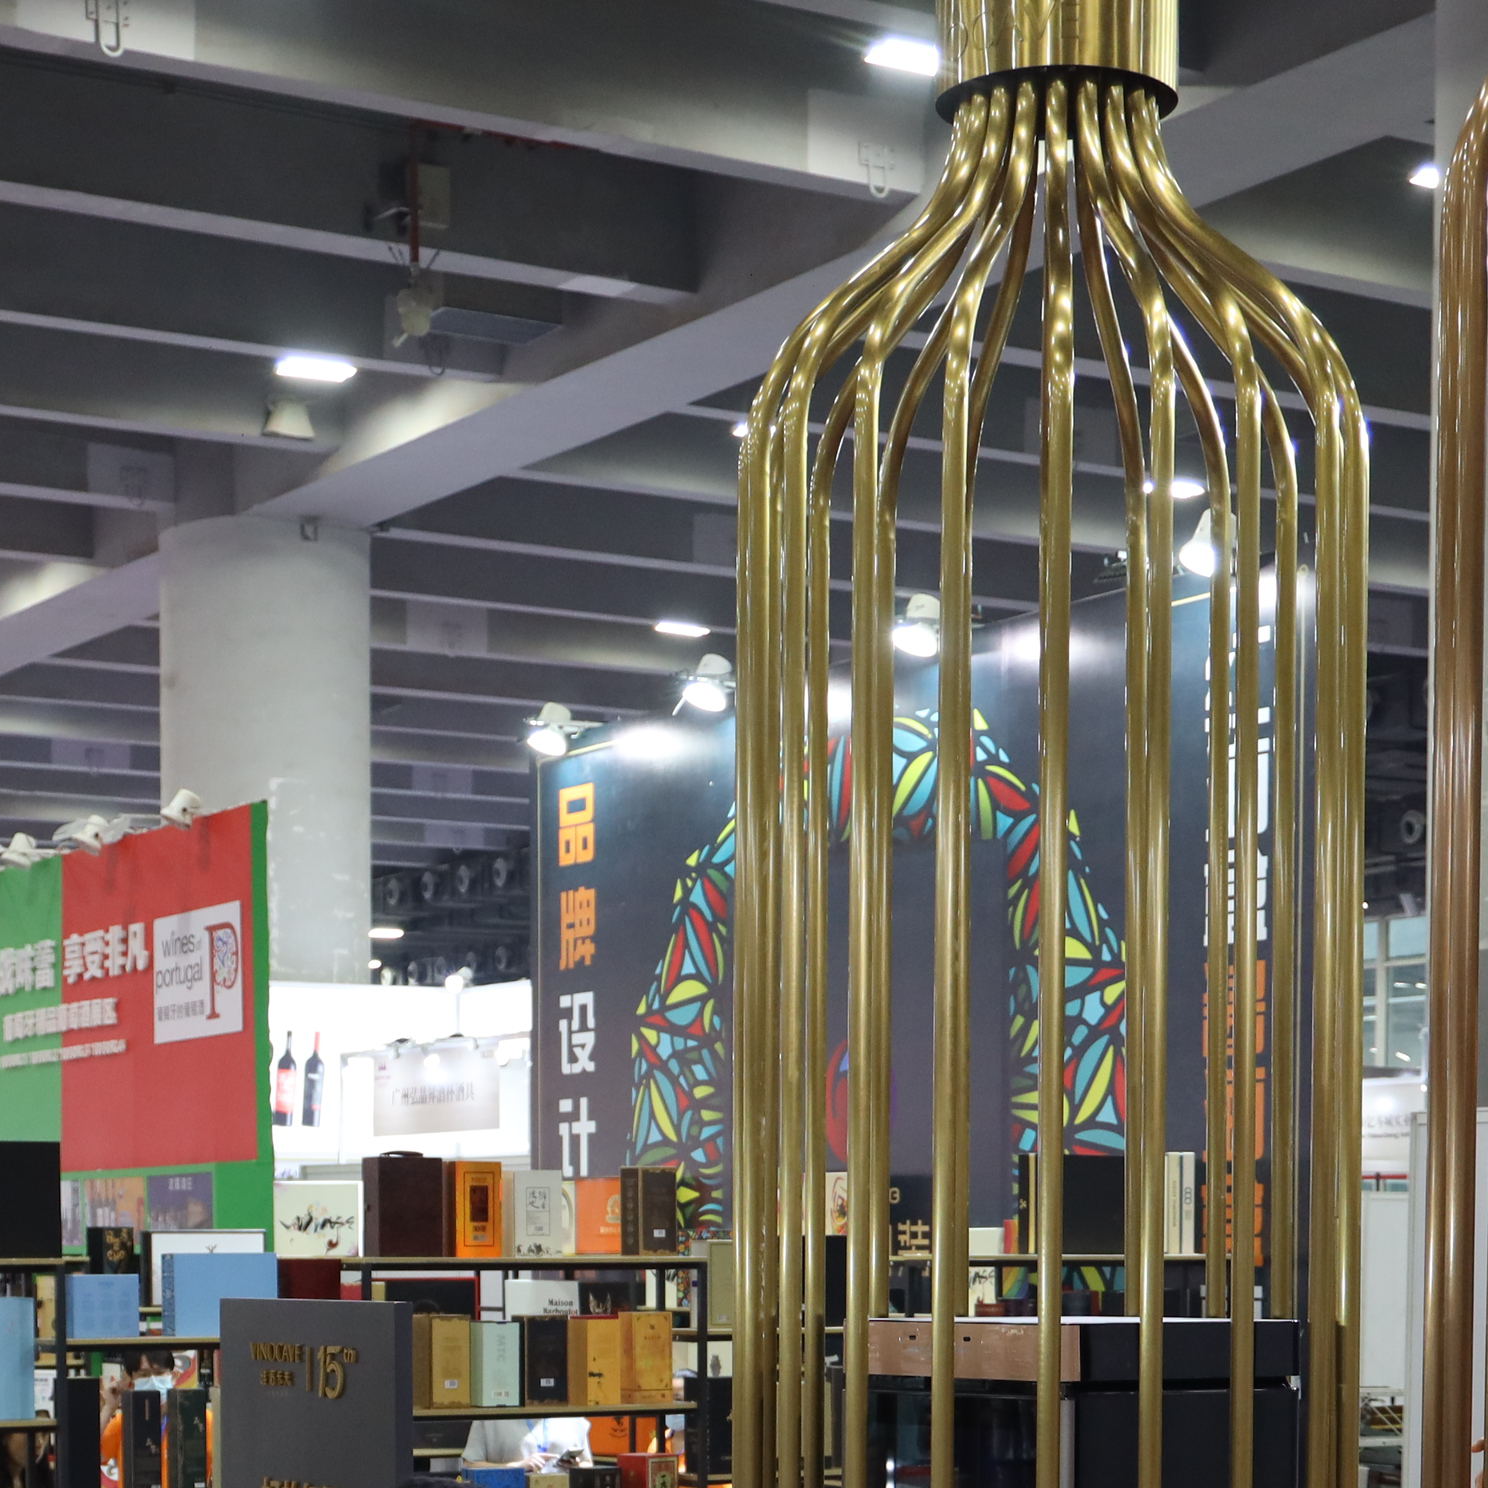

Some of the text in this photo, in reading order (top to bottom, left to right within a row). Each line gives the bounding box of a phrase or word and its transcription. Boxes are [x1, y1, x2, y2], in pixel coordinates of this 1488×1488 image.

[63, 922, 149, 984] 享受非凡
[162, 930, 195, 958] wines
[156, 957, 203, 994] portugal
[558, 781, 597, 1178] 品牌设计
[548, 1298, 574, 1306] Maison
[250, 1342, 302, 1363] VINOCAVE
